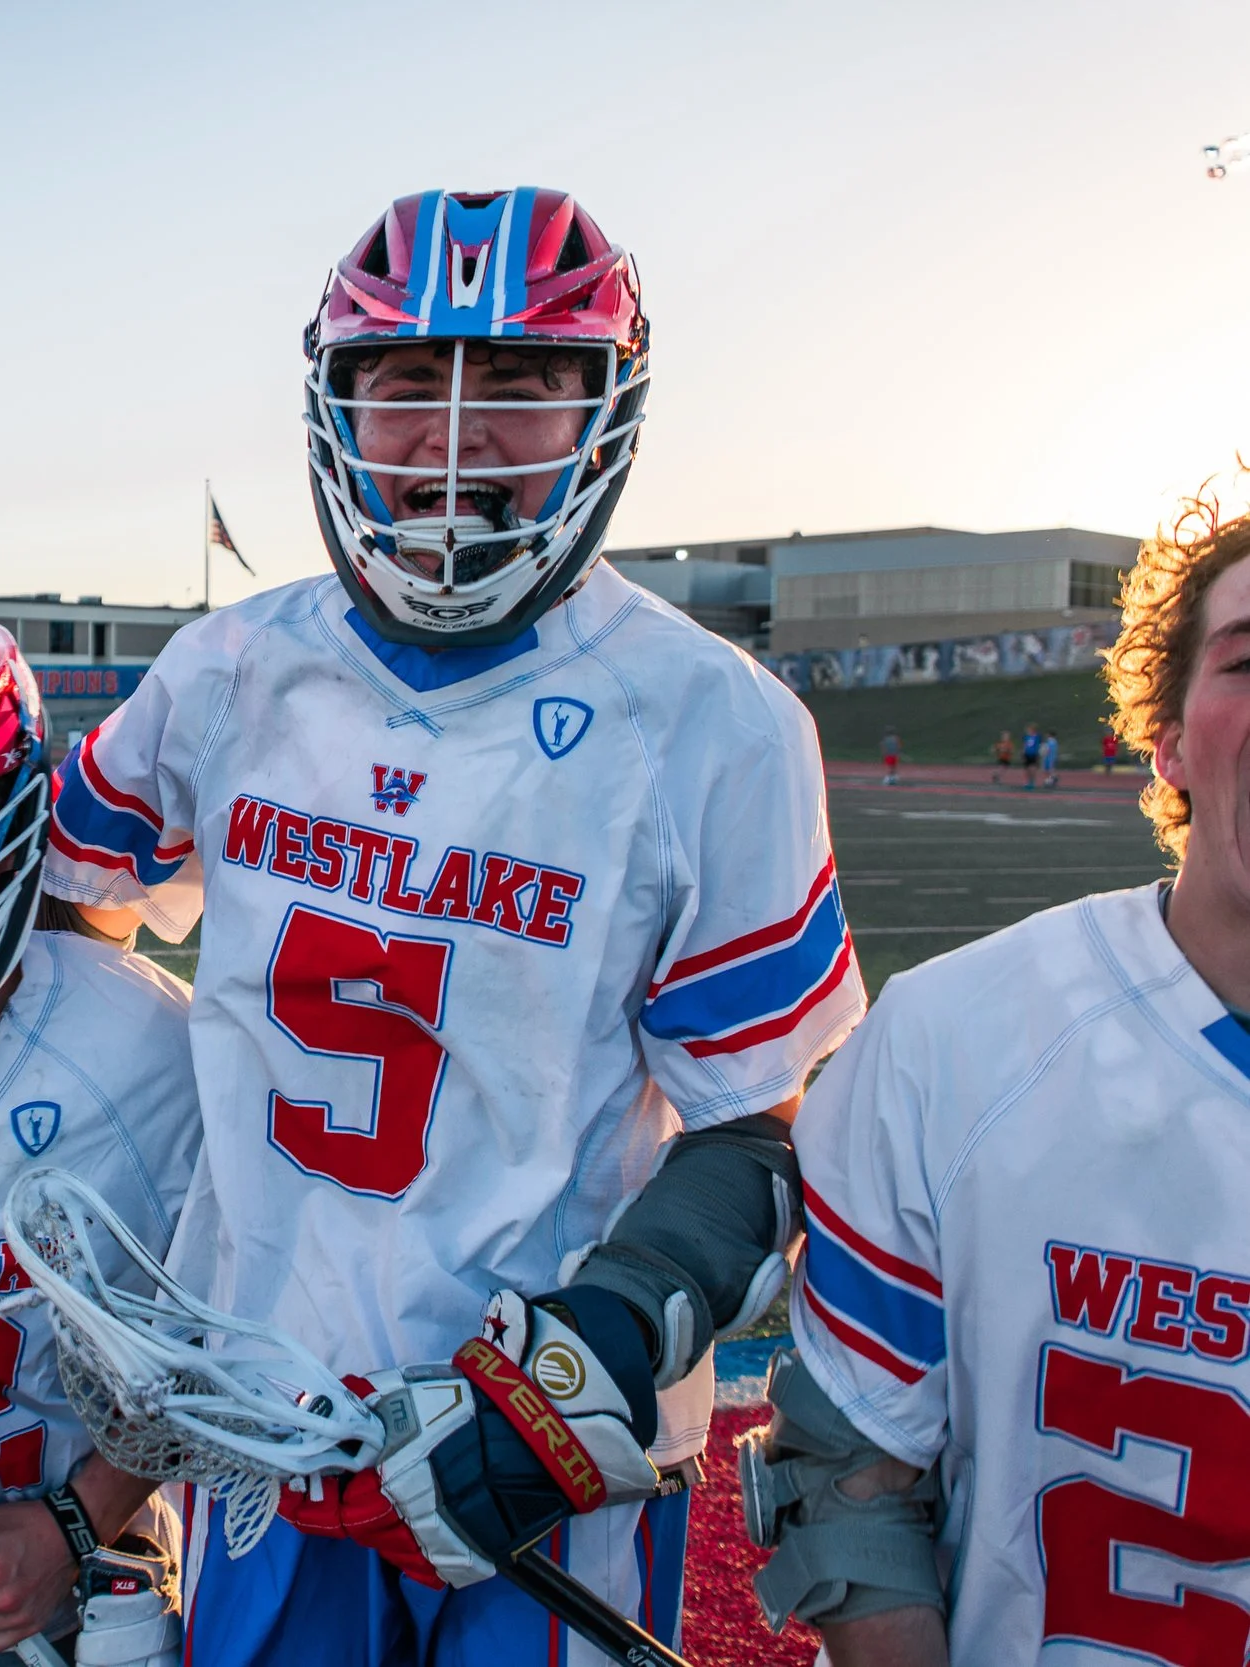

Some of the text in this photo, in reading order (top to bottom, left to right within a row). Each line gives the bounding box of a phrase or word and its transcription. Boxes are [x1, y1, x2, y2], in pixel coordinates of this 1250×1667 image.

[412, 618, 484, 629] cascade
[370, 763, 426, 816] W
[221, 793, 586, 948] WESTLAKE
[265, 901, 455, 1202] 5
[1044, 1239, 1250, 1366] WES
[1034, 1340, 1250, 1667] 2
[114, 1580, 136, 1591] STX
